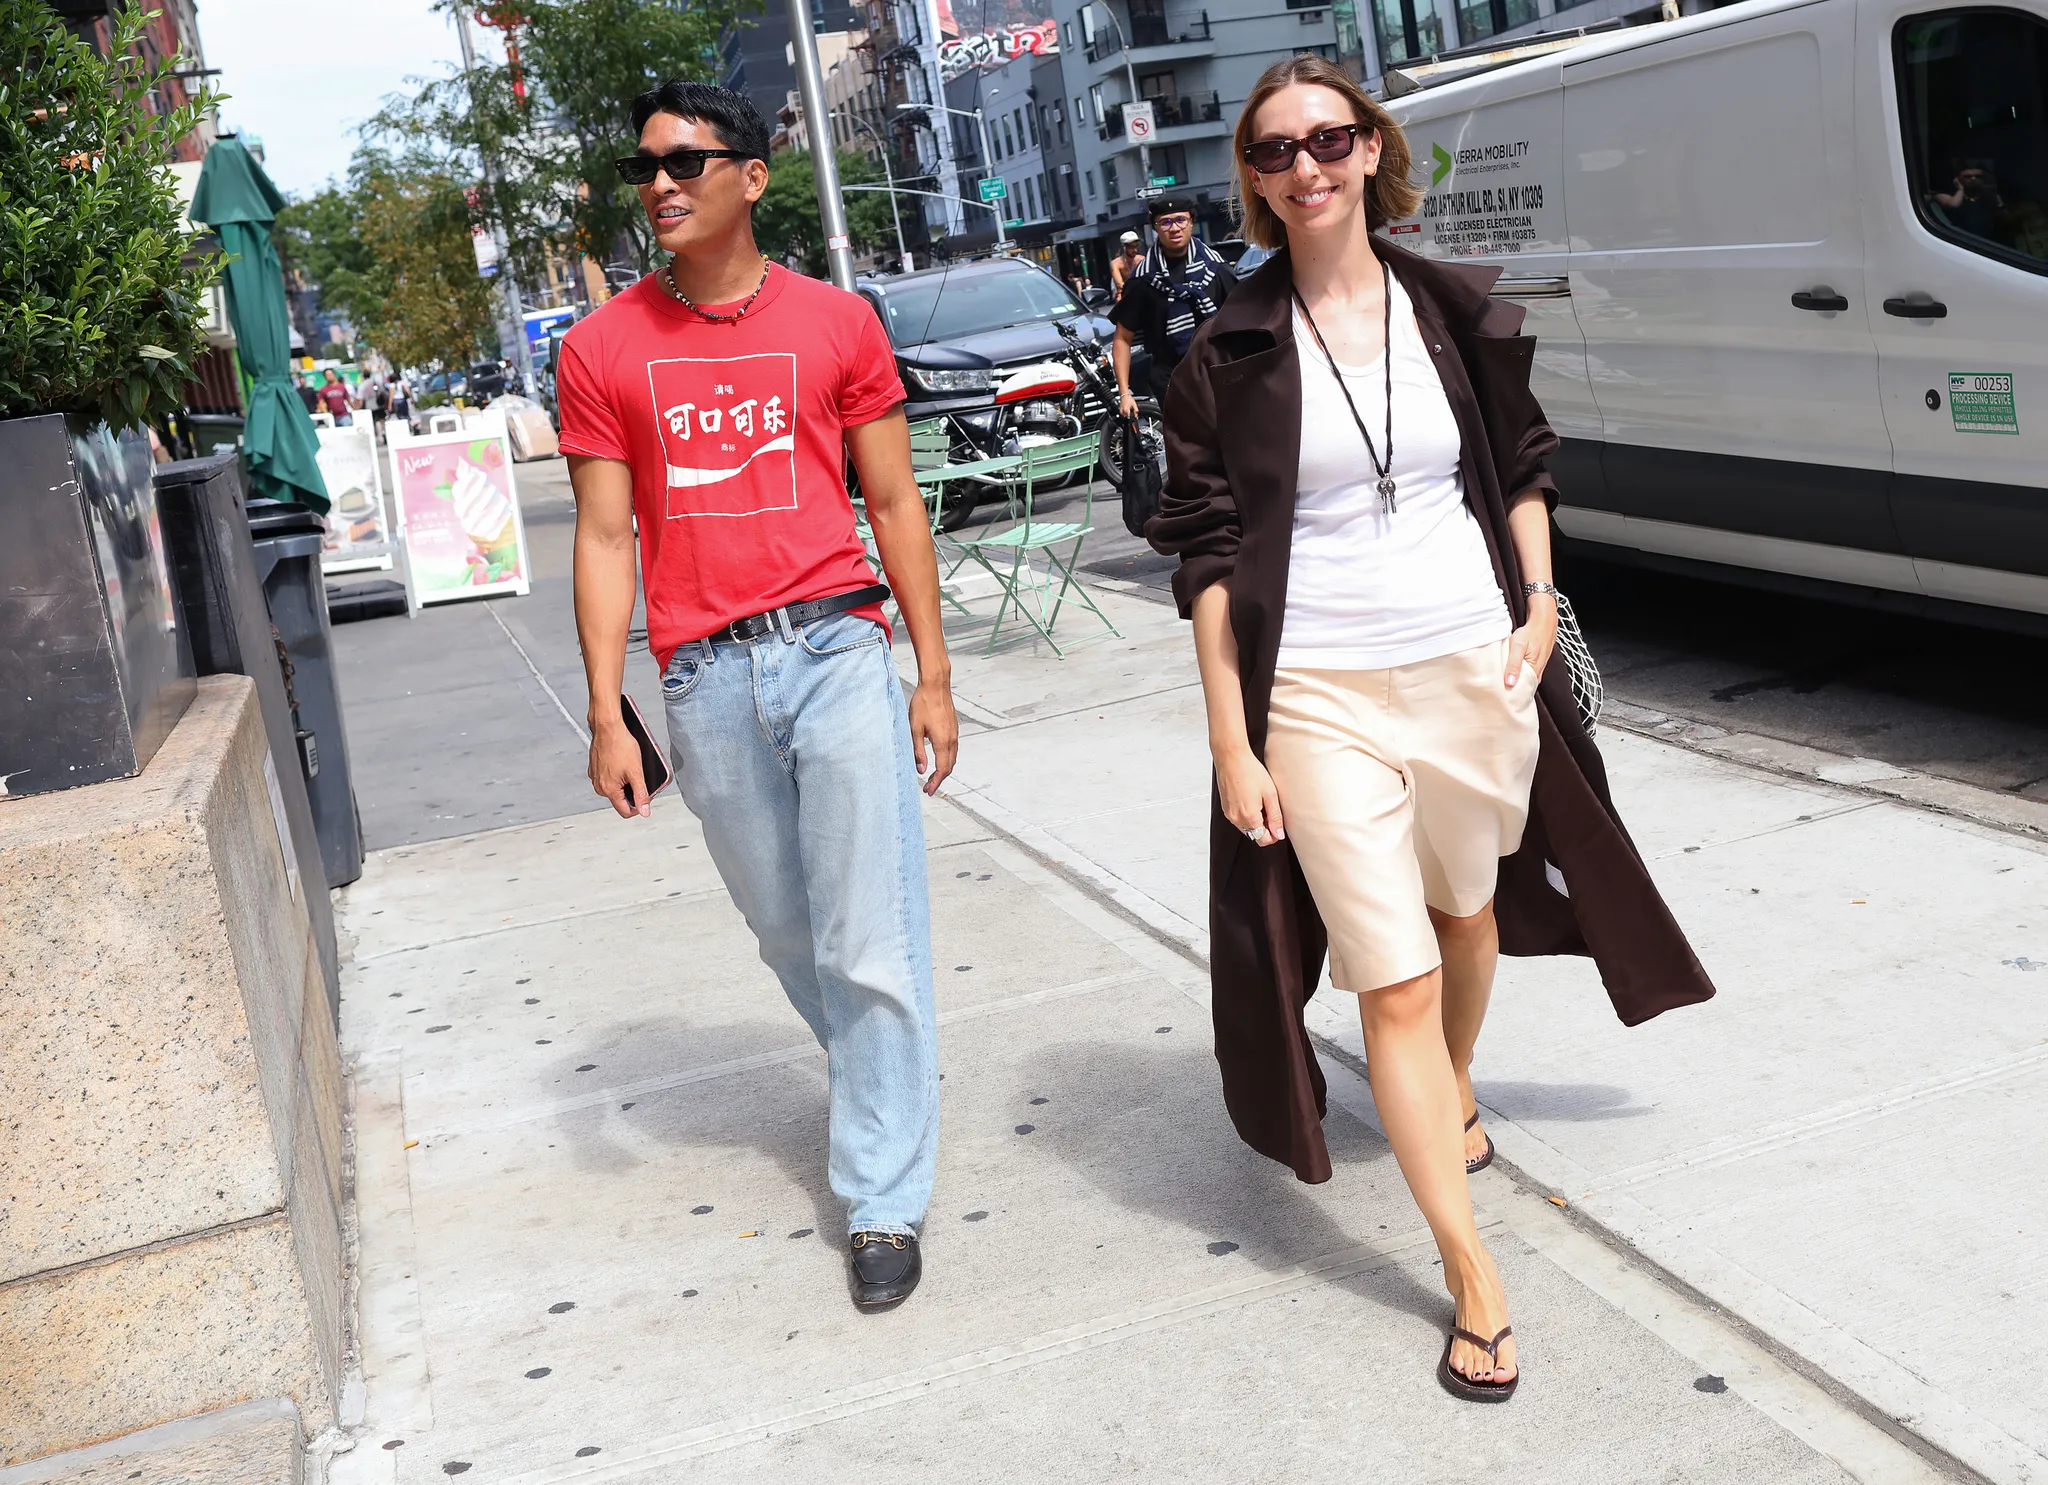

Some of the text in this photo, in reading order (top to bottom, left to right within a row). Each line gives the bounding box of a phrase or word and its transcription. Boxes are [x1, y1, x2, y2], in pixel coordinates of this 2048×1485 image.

[1453, 140, 1530, 165] VERRA MOBILITY
[1455, 160, 1521, 176] Electrical Enterprises, Inc.
[1423, 195, 1438, 219] 3120
[1438, 191, 1466, 217] ARTHUR
[1466, 190, 1482, 214] KILL
[1508, 186, 1520, 211] NY
[1521, 184, 1544, 210] 10309
[1435, 215, 1532, 233] N.Y.C. LICENSED ELECTRICIAN
[1434, 233, 1461, 245] LICENSE
[1467, 232, 1487, 243] 13209
[1492, 230, 1510, 241] FIRM
[1511, 228, 1536, 240] #03875
[1450, 242, 1521, 256] PHONE 718-448-7000
[713, 384, 735, 396] 请喝
[1951, 377, 1965, 385] NYC
[1974, 376, 2010, 391] 00253
[1951, 392, 2012, 405] PROCESSING DEVICE
[663, 394, 787, 441] 可口可乐
[1988, 406, 2013, 414] PERMITTED
[2003, 415, 2014, 423] USE
[403, 453, 436, 476] New
